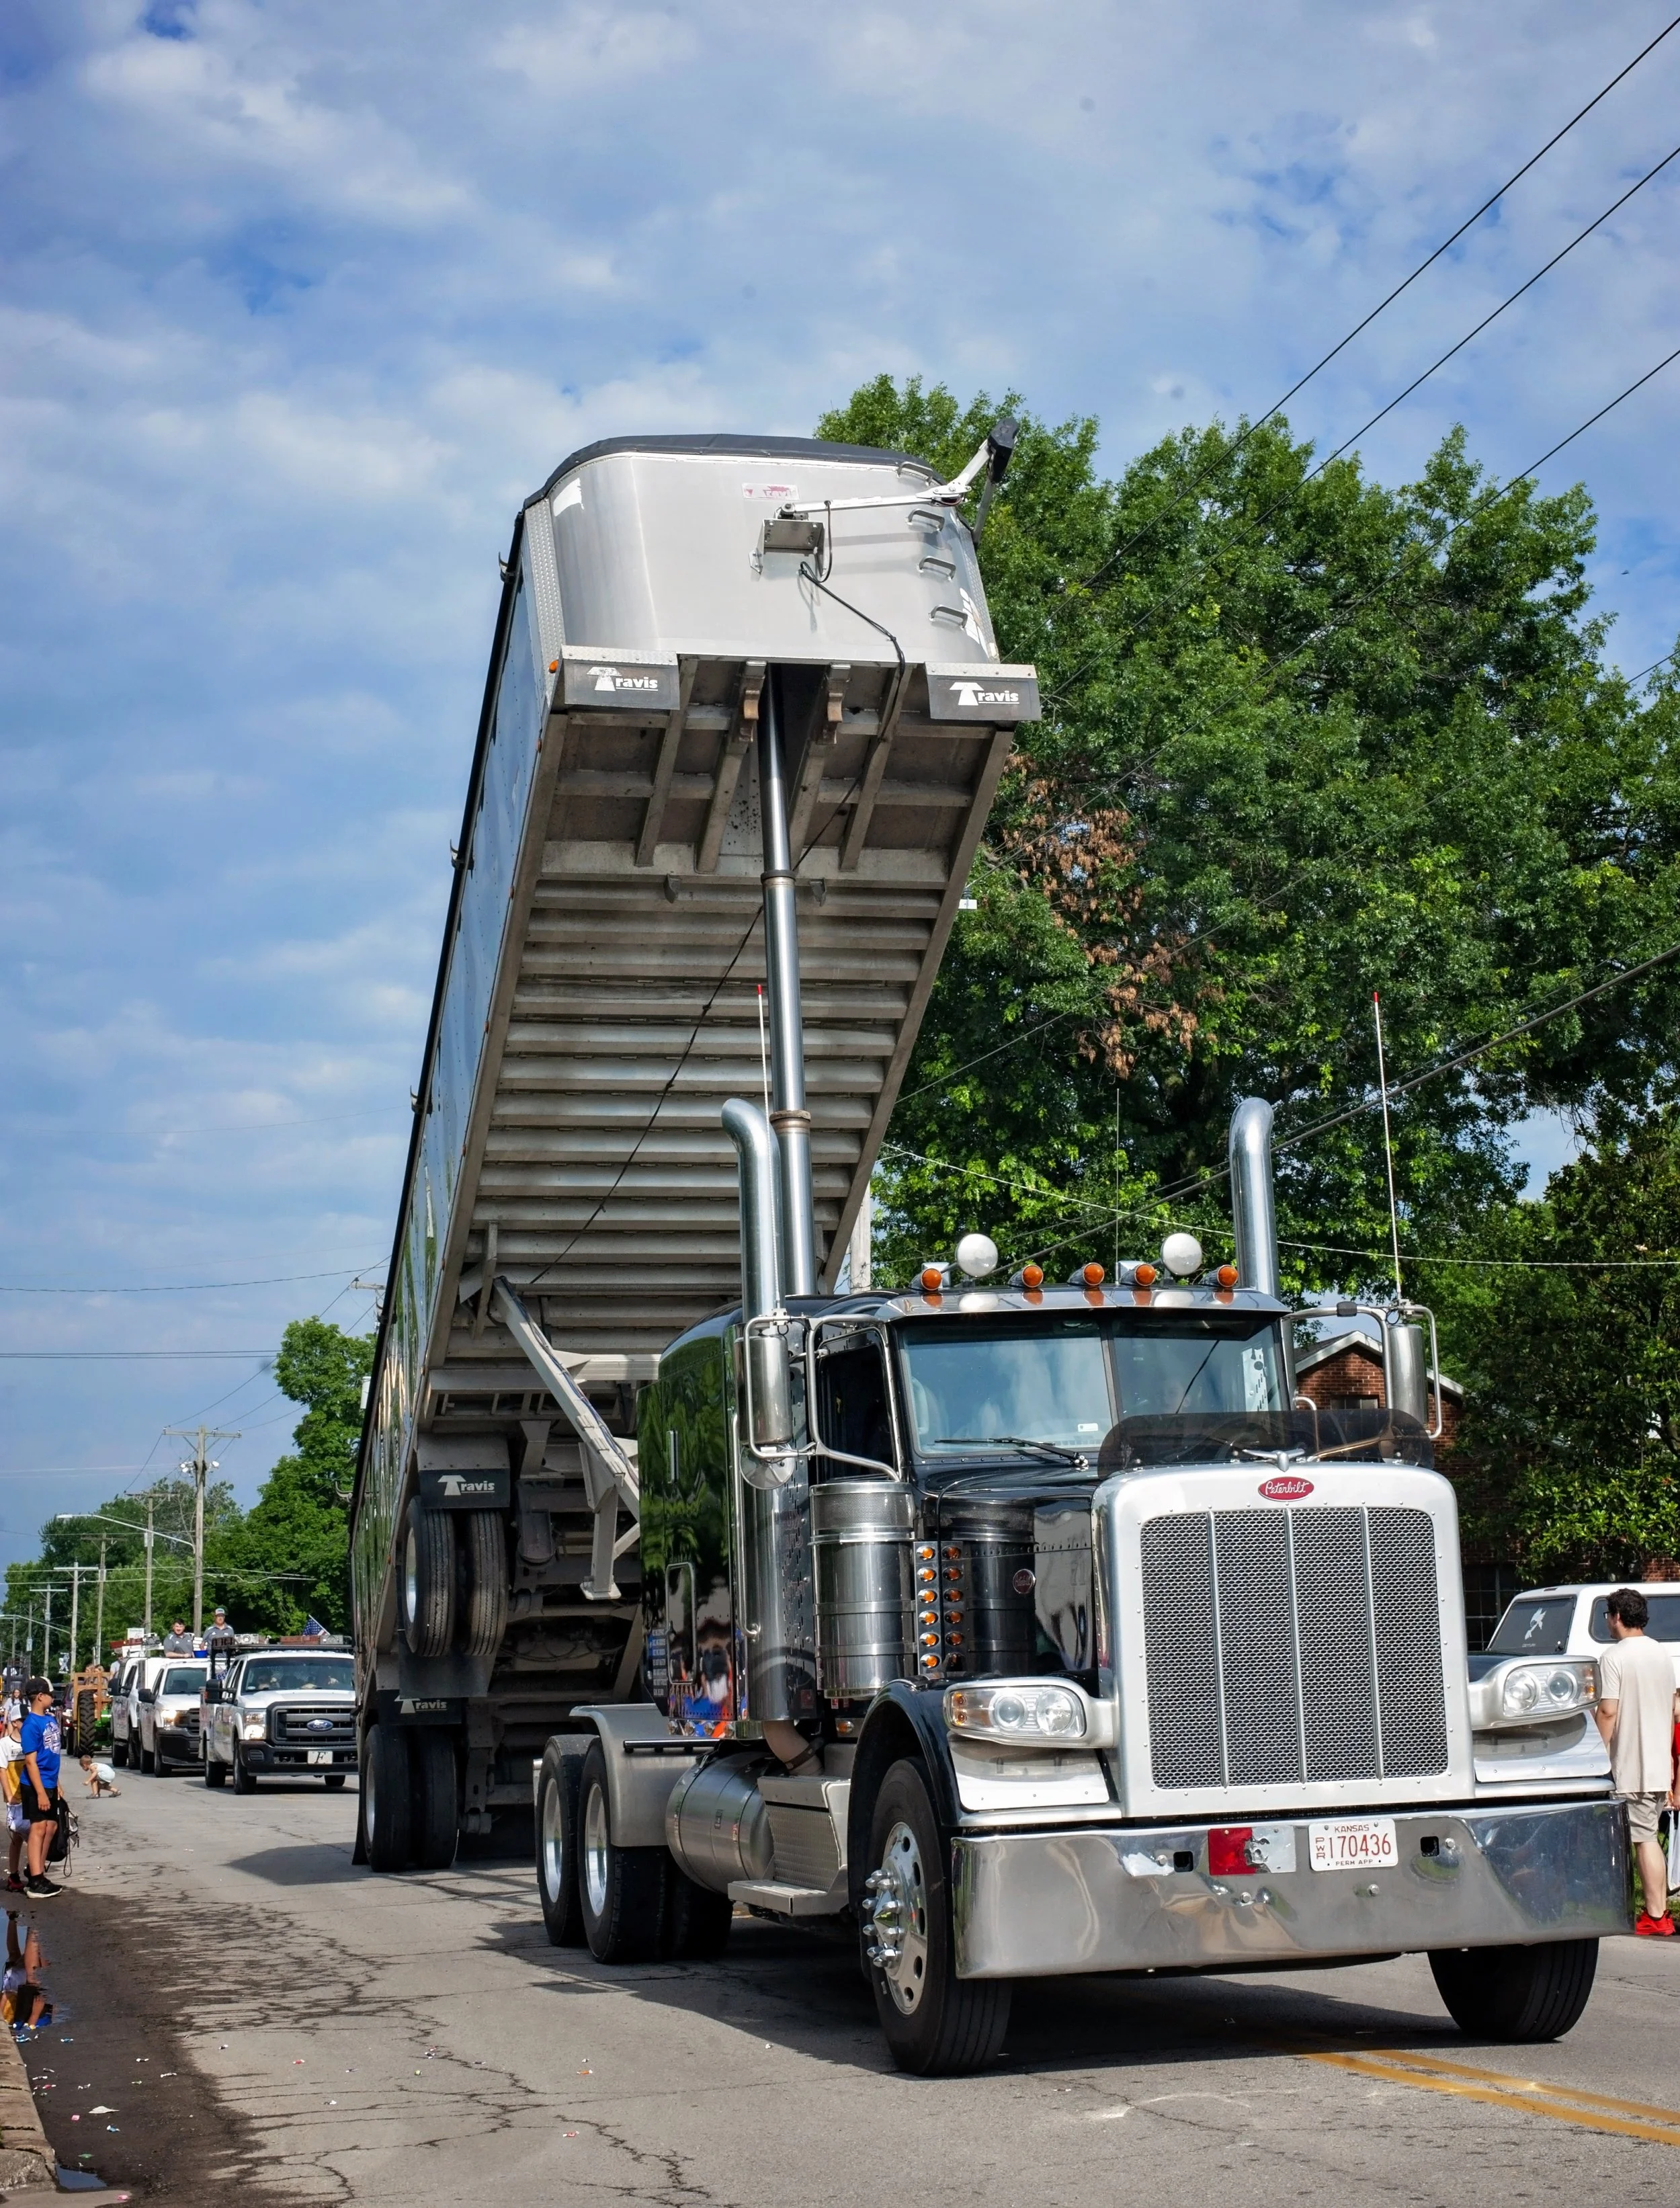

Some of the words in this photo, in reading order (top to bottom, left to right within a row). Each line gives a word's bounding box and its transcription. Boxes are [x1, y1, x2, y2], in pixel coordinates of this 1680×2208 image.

[587, 667, 658, 692] Travis
[950, 682, 1019, 706] Travis
[437, 1475, 495, 1496] Travis
[1265, 1481, 1310, 1496] Peterbilt
[394, 1694, 447, 1714] Travis
[1334, 1824, 1370, 1833] KANSAS
[1329, 1833, 1391, 1858] 170436
